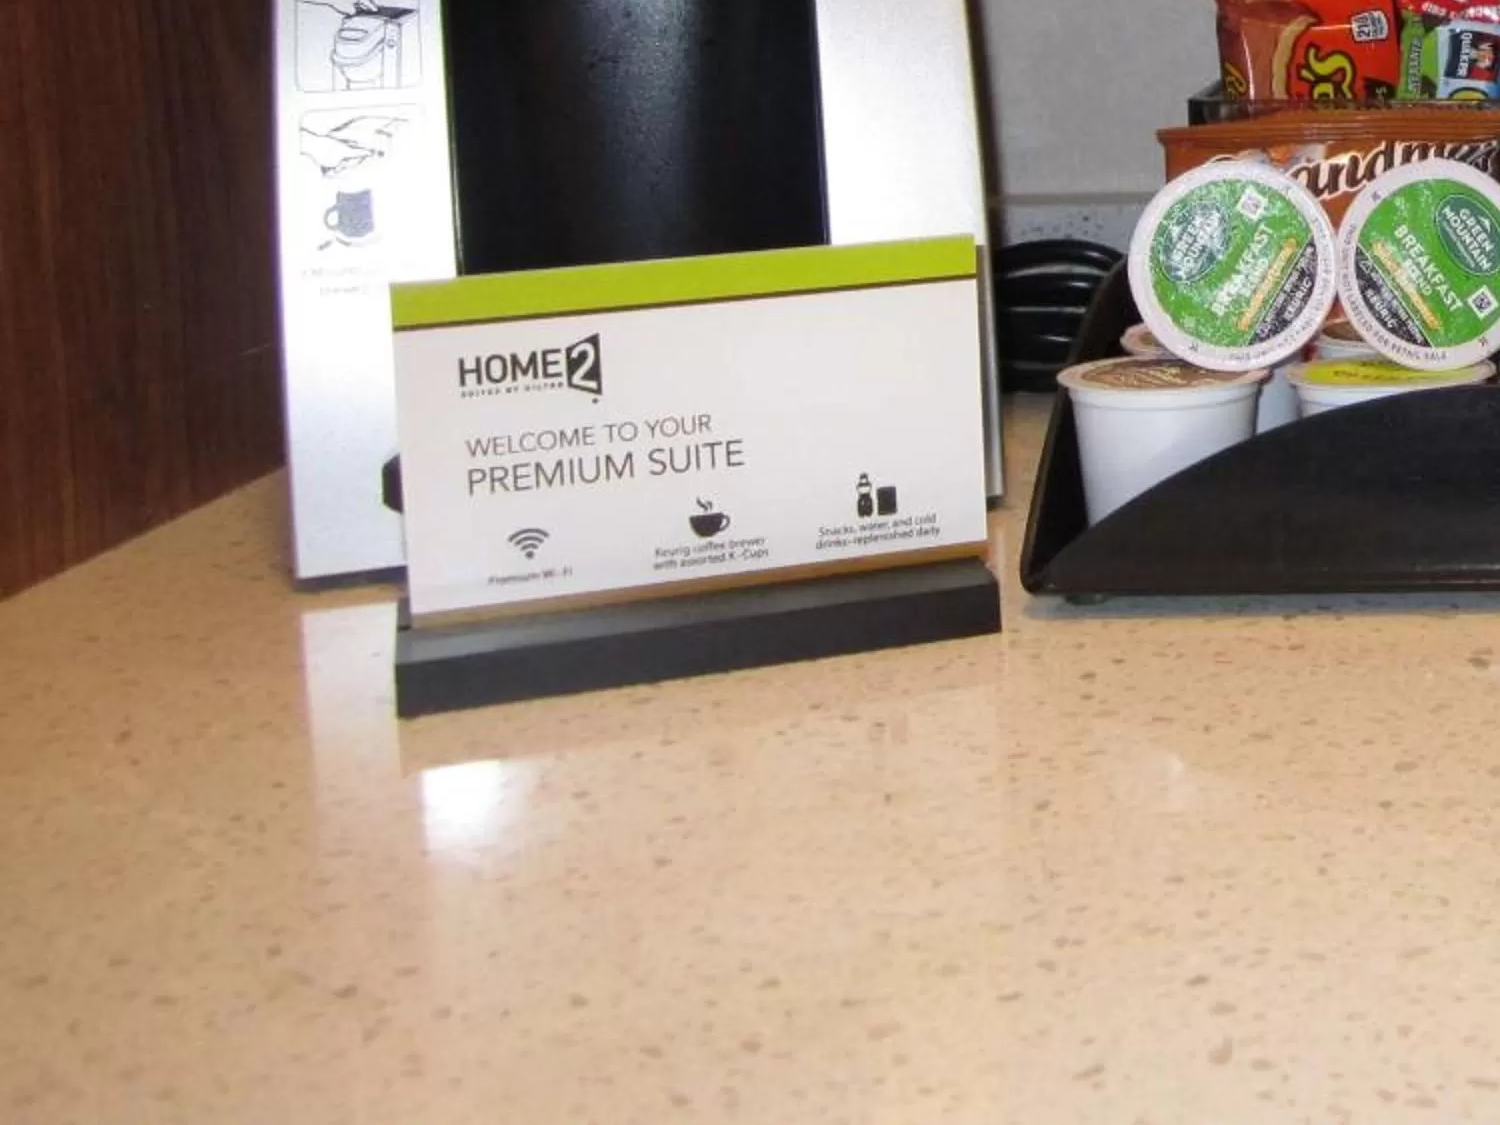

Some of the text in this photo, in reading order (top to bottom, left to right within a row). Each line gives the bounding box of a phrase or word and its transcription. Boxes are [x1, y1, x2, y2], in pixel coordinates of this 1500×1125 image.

[1441, 206, 1493, 271] MOUNTAIN
[1459, 208, 1495, 252] GREEN
[1394, 225, 1463, 312] BREAKFAST
[465, 414, 711, 458] WELCOME TO YOUR
[467, 439, 745, 496] PREMIUM SUITE
